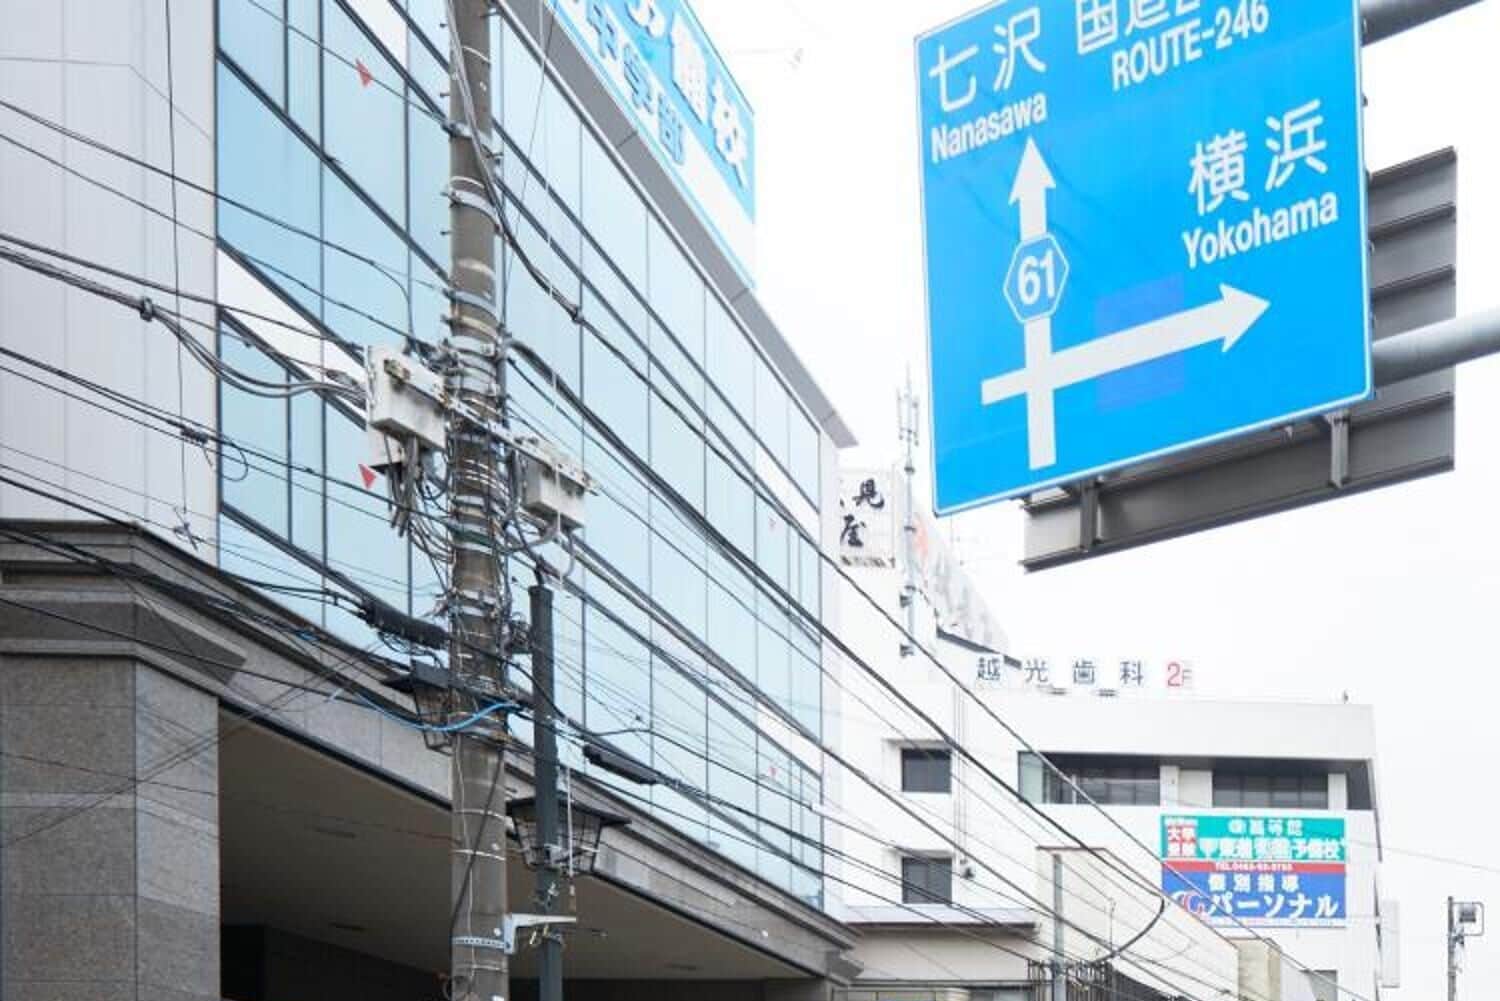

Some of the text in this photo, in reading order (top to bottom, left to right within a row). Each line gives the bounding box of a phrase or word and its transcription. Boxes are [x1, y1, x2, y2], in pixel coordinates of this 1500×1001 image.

[928, 6, 1047, 112] 七沢
[1111, 0, 1270, 92] ROUTE-246
[930, 92, 1048, 161] Nanasawa
[1188, 98, 1329, 217] 横浜
[1182, 190, 1340, 269] Yokohama
[1017, 248, 1055, 305] 61
[1210, 892, 1339, 919] パーソナル
